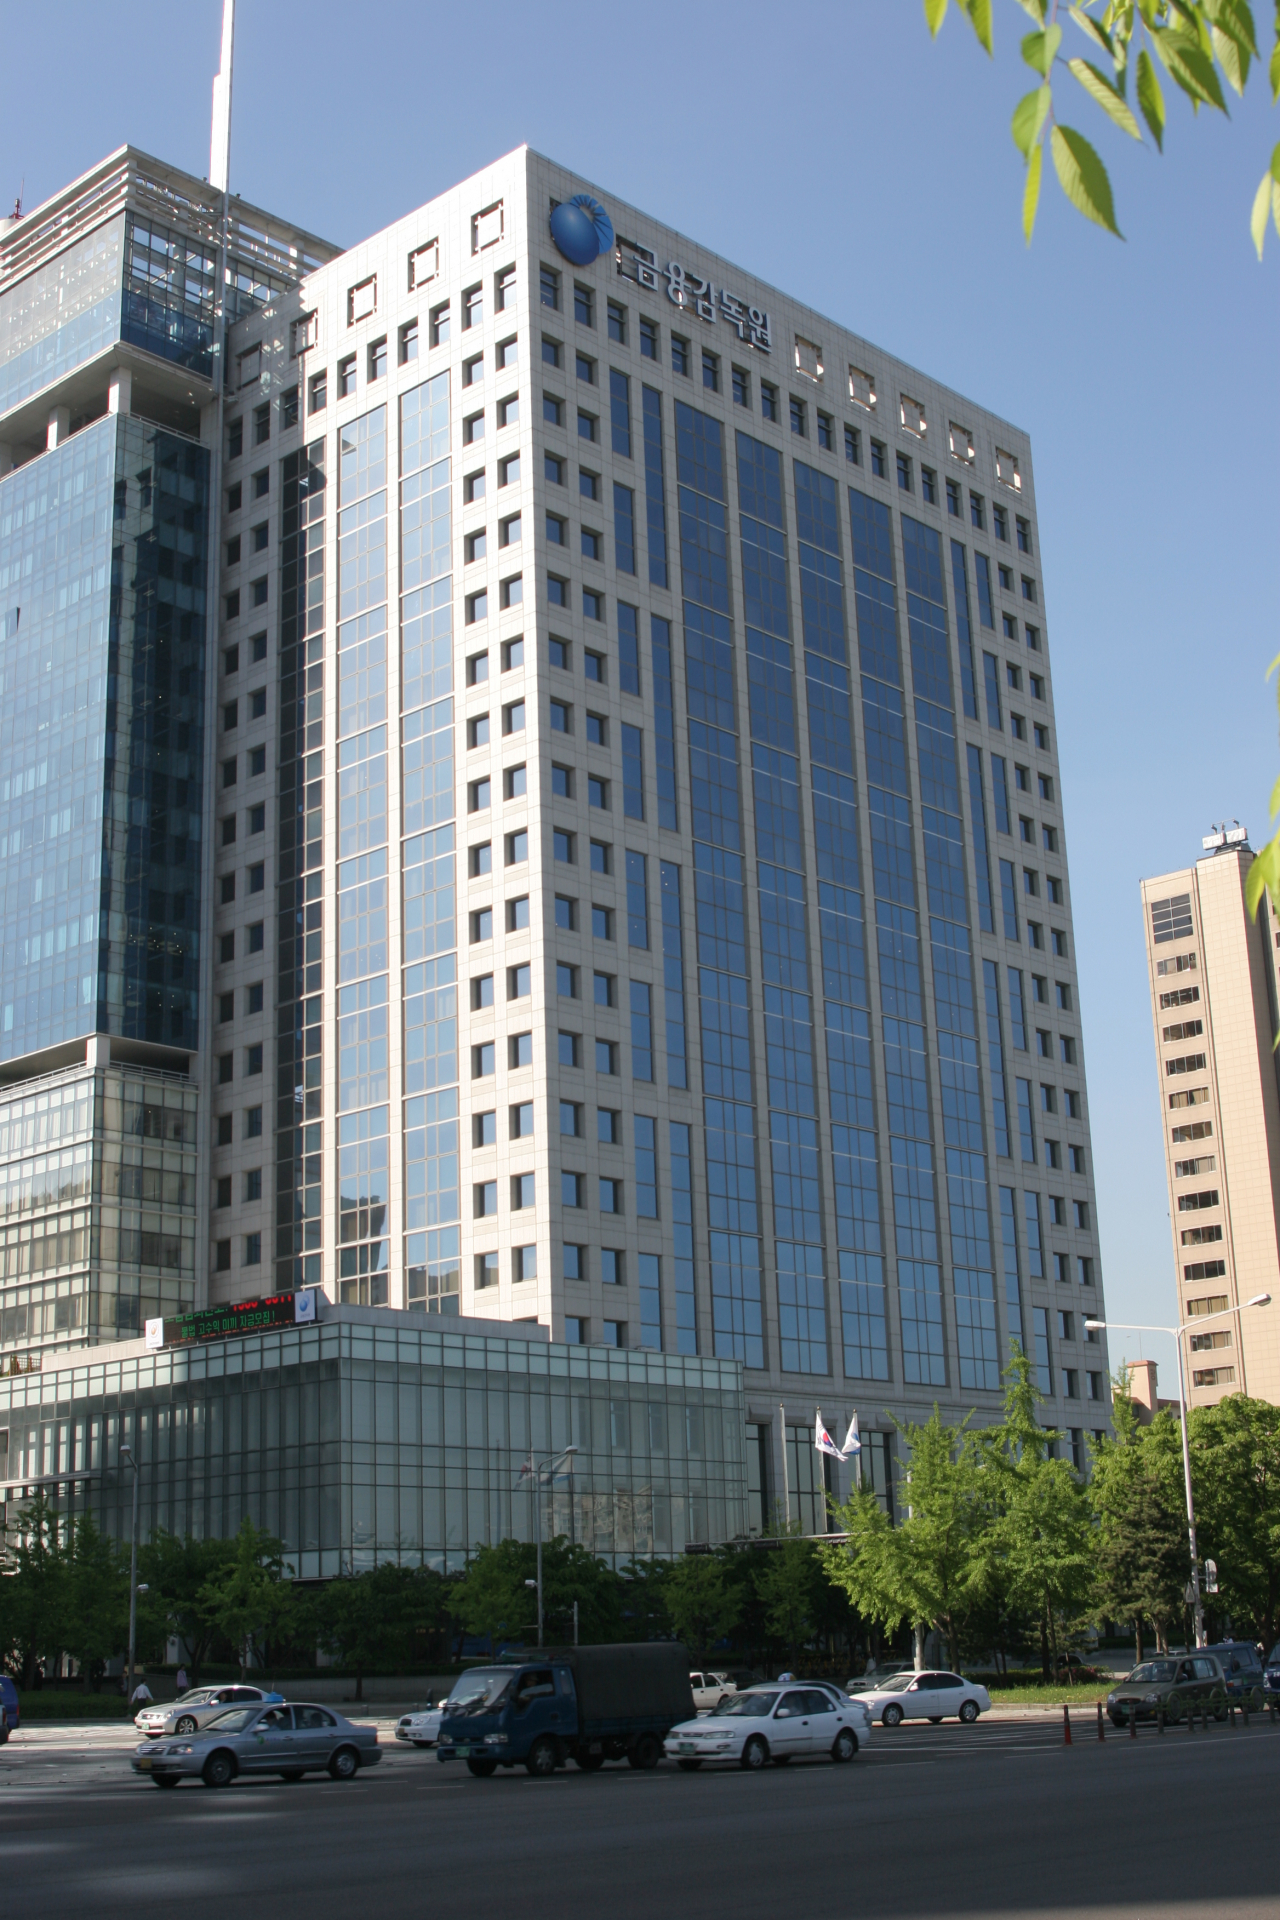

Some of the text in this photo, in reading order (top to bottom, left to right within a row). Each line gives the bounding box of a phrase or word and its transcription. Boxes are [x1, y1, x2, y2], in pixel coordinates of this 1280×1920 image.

[633, 241, 772, 354] 금융감독원
[198, 1319, 220, 1335] 고수익
[222, 1316, 238, 1331] 미끼
